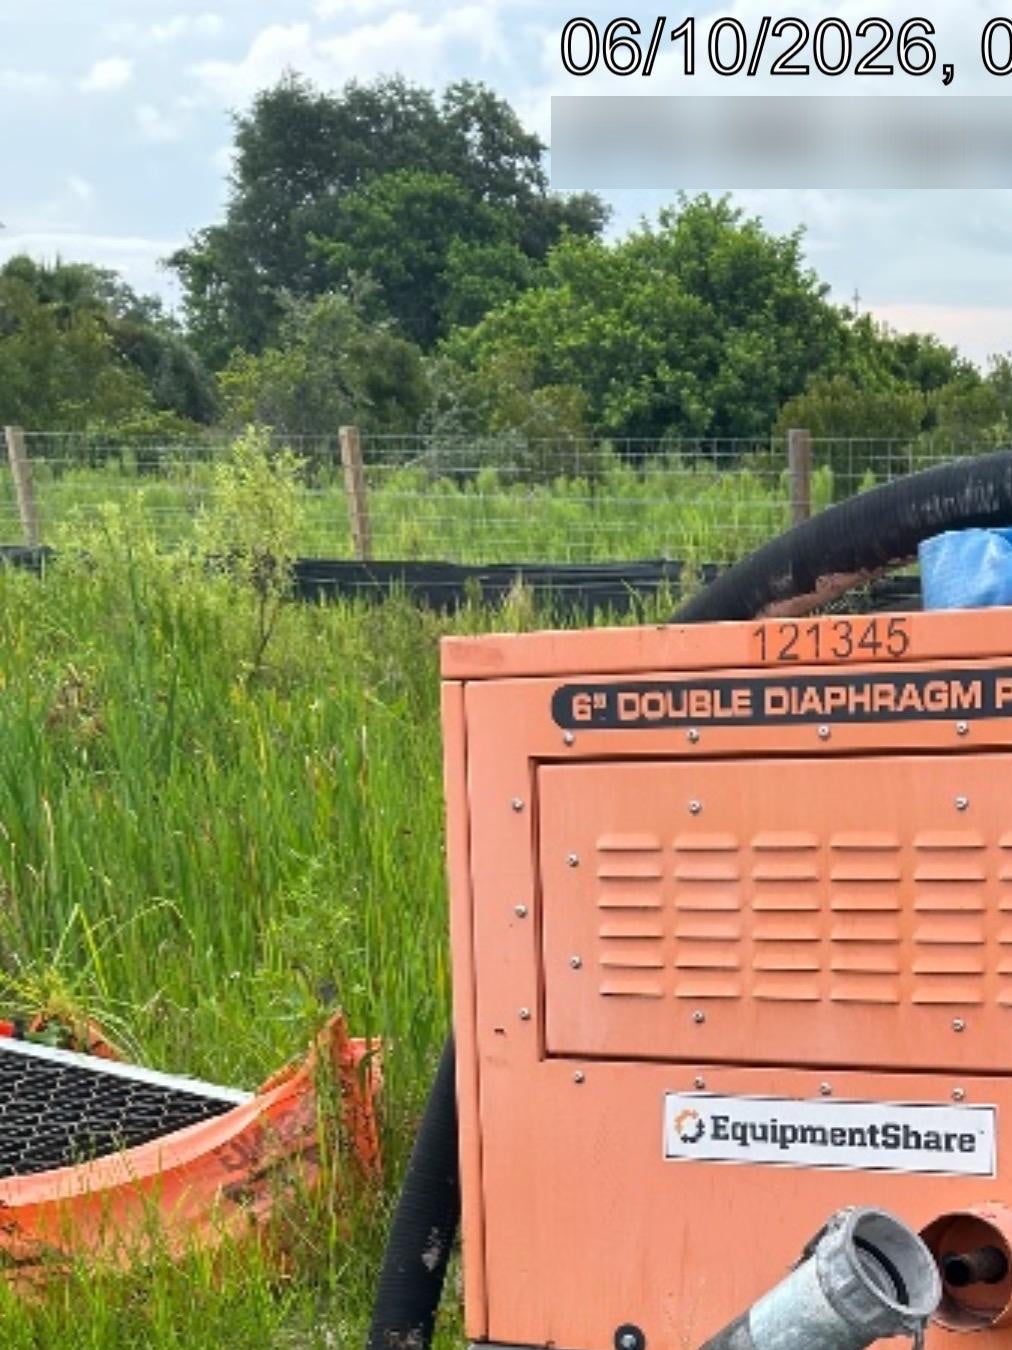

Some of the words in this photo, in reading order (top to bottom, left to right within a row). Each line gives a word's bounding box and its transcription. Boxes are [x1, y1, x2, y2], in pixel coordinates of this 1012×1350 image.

[753, 618, 910, 661] 121345
[617, 688, 753, 721] DOUBLE
[763, 680, 982, 715] DIAPHRAGM
[710, 1115, 977, 1152] EquipmentShare
